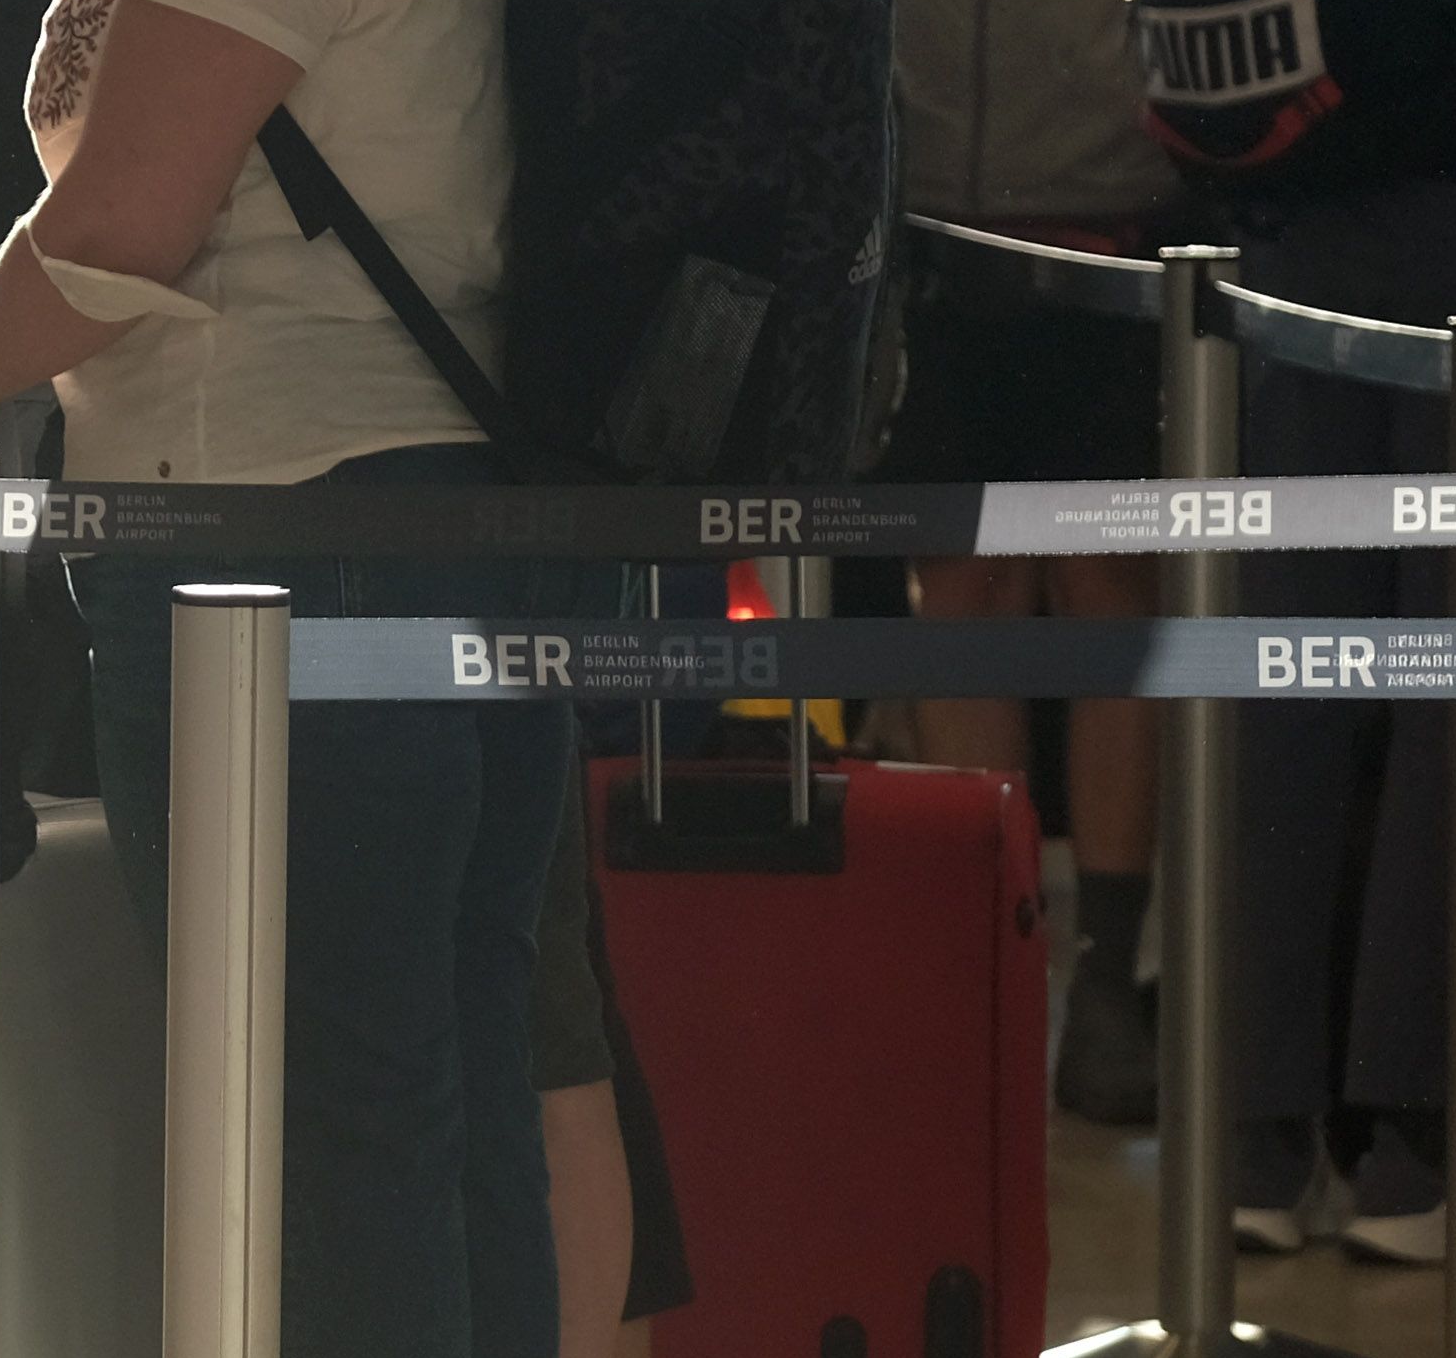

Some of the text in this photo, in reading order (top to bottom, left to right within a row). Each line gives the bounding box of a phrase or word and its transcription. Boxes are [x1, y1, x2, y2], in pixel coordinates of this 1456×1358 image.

[116, 494, 166, 507] BERLIN
[812, 497, 862, 509] BERLIN
[2, 492, 107, 539] BER
[116, 510, 222, 526] BRANDENBURG
[700, 499, 804, 544] BER
[812, 513, 918, 526] BRANDENBURG
[115, 528, 176, 541] AIRPORT
[811, 530, 871, 542] AIRPORT
[583, 635, 640, 649] BERLIN
[451, 633, 574, 686] BER
[583, 654, 706, 669] BRANDENBURG
[1257, 636, 1377, 688] BER
[583, 674, 653, 688] AIRPORT
